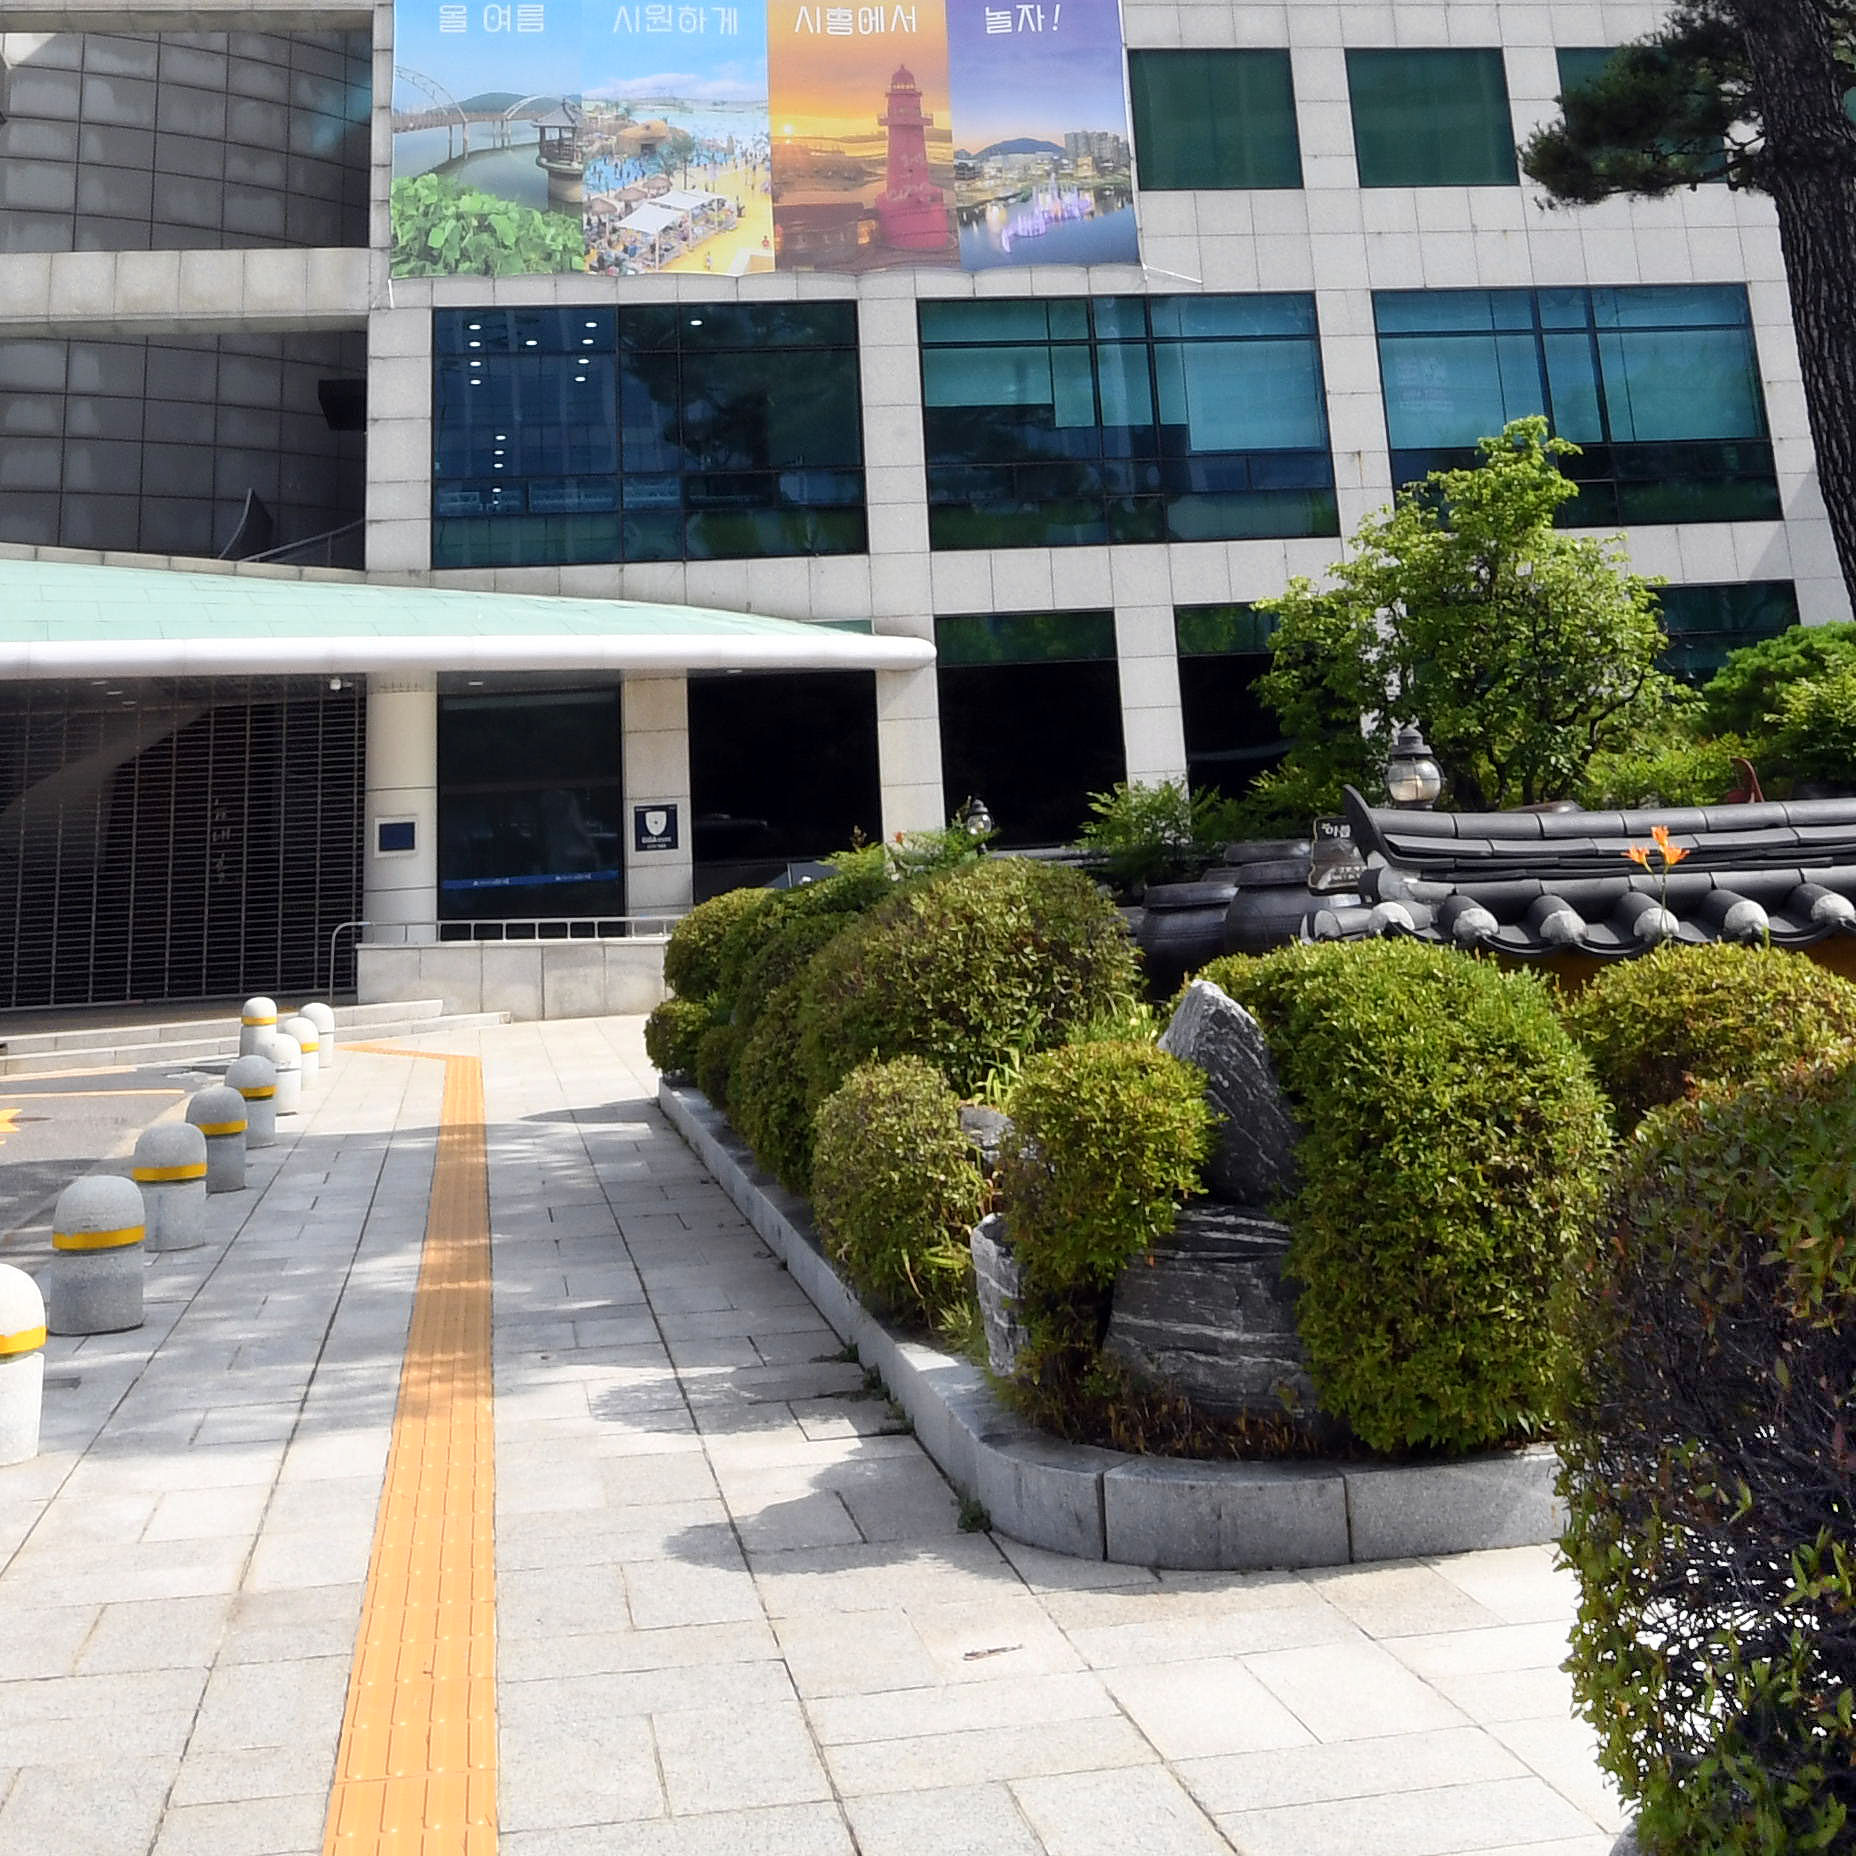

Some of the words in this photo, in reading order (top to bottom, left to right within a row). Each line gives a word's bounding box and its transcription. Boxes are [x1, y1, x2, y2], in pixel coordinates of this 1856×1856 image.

[439, 5, 467, 33] 올
[483, 4, 545, 33] 여름
[612, 4, 739, 36] 시원하게
[795, 4, 917, 36] 시흥에서
[985, 4, 1061, 34] 놀자!
